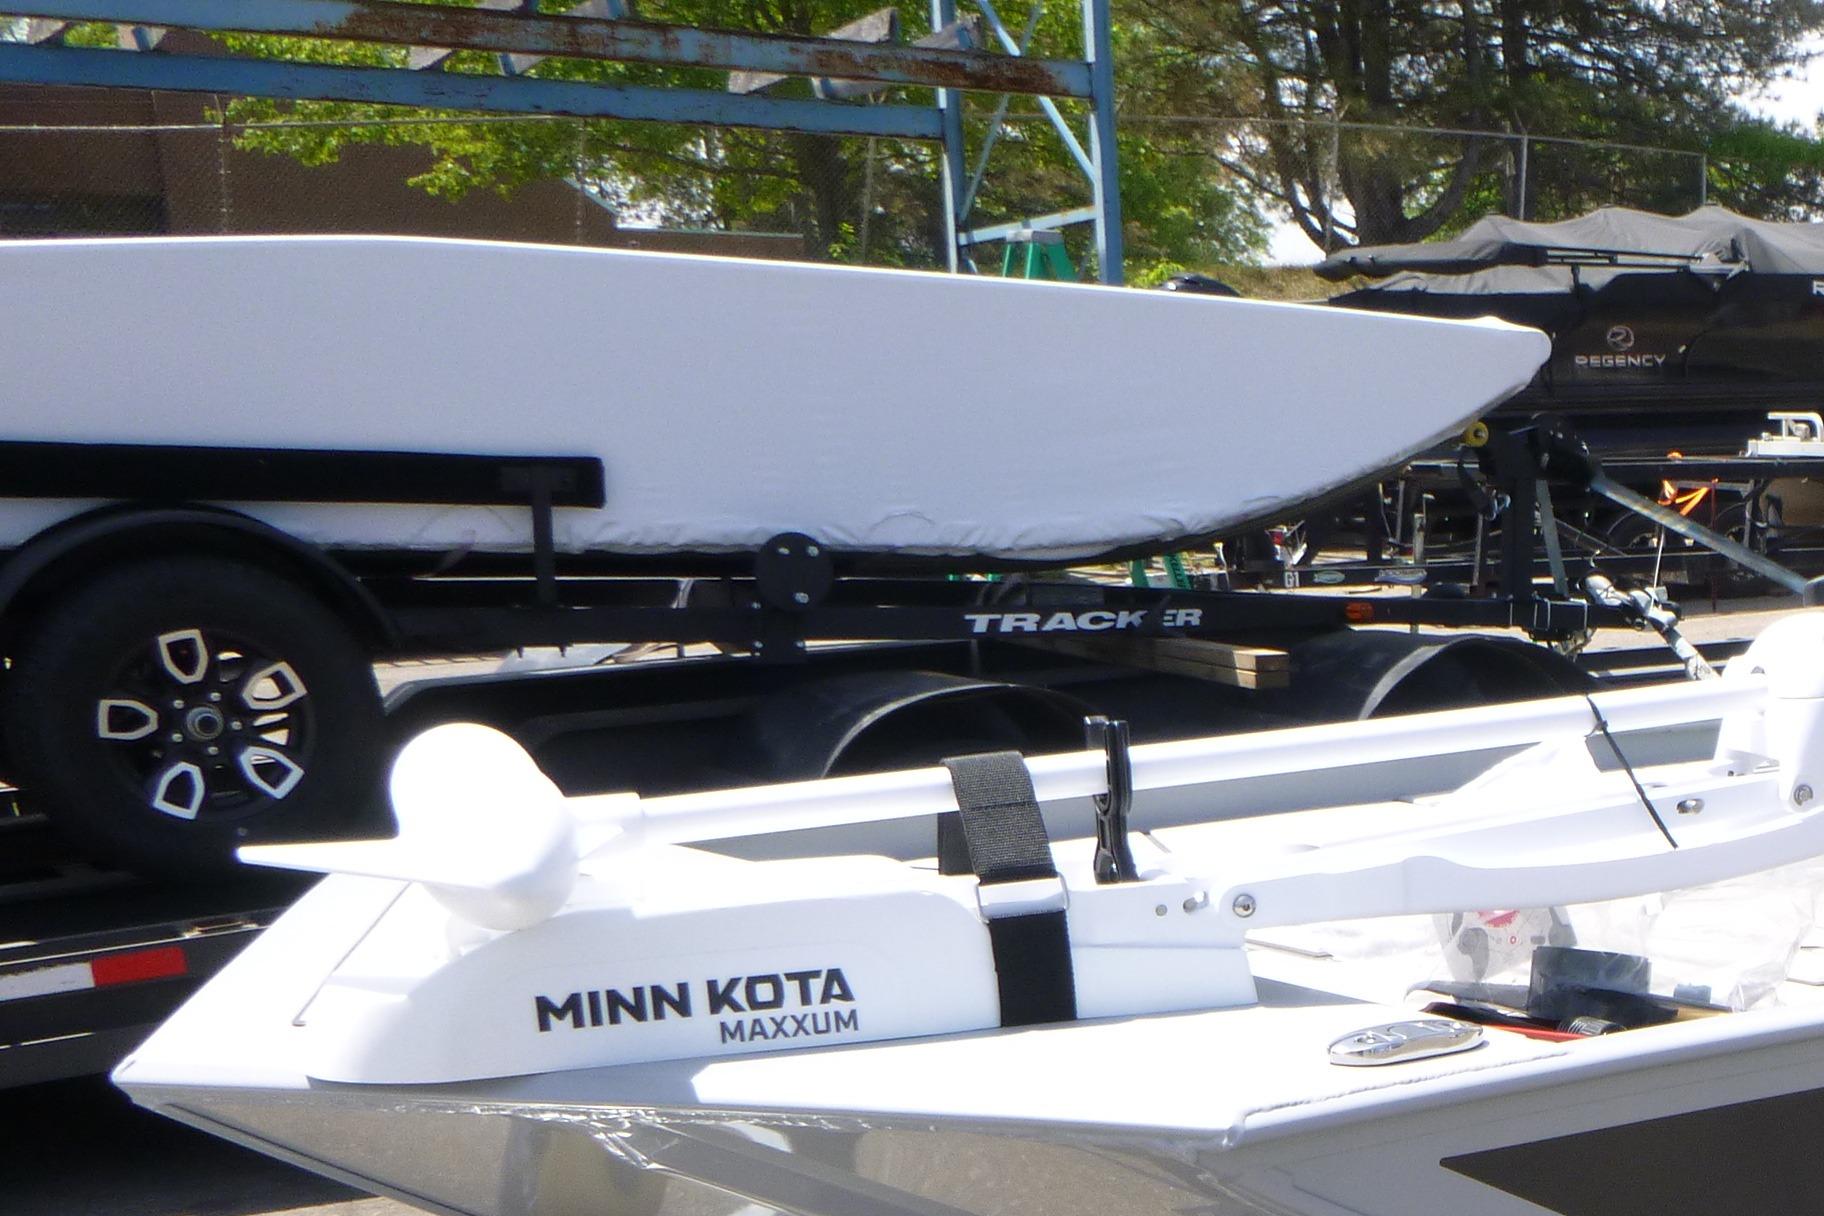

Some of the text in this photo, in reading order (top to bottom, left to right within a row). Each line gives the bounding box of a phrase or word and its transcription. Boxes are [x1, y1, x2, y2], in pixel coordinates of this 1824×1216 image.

[1575, 354, 1666, 369] REGENCY
[534, 967, 856, 1033] MINN KOTA
[719, 1008, 860, 1045] MAXXUM
